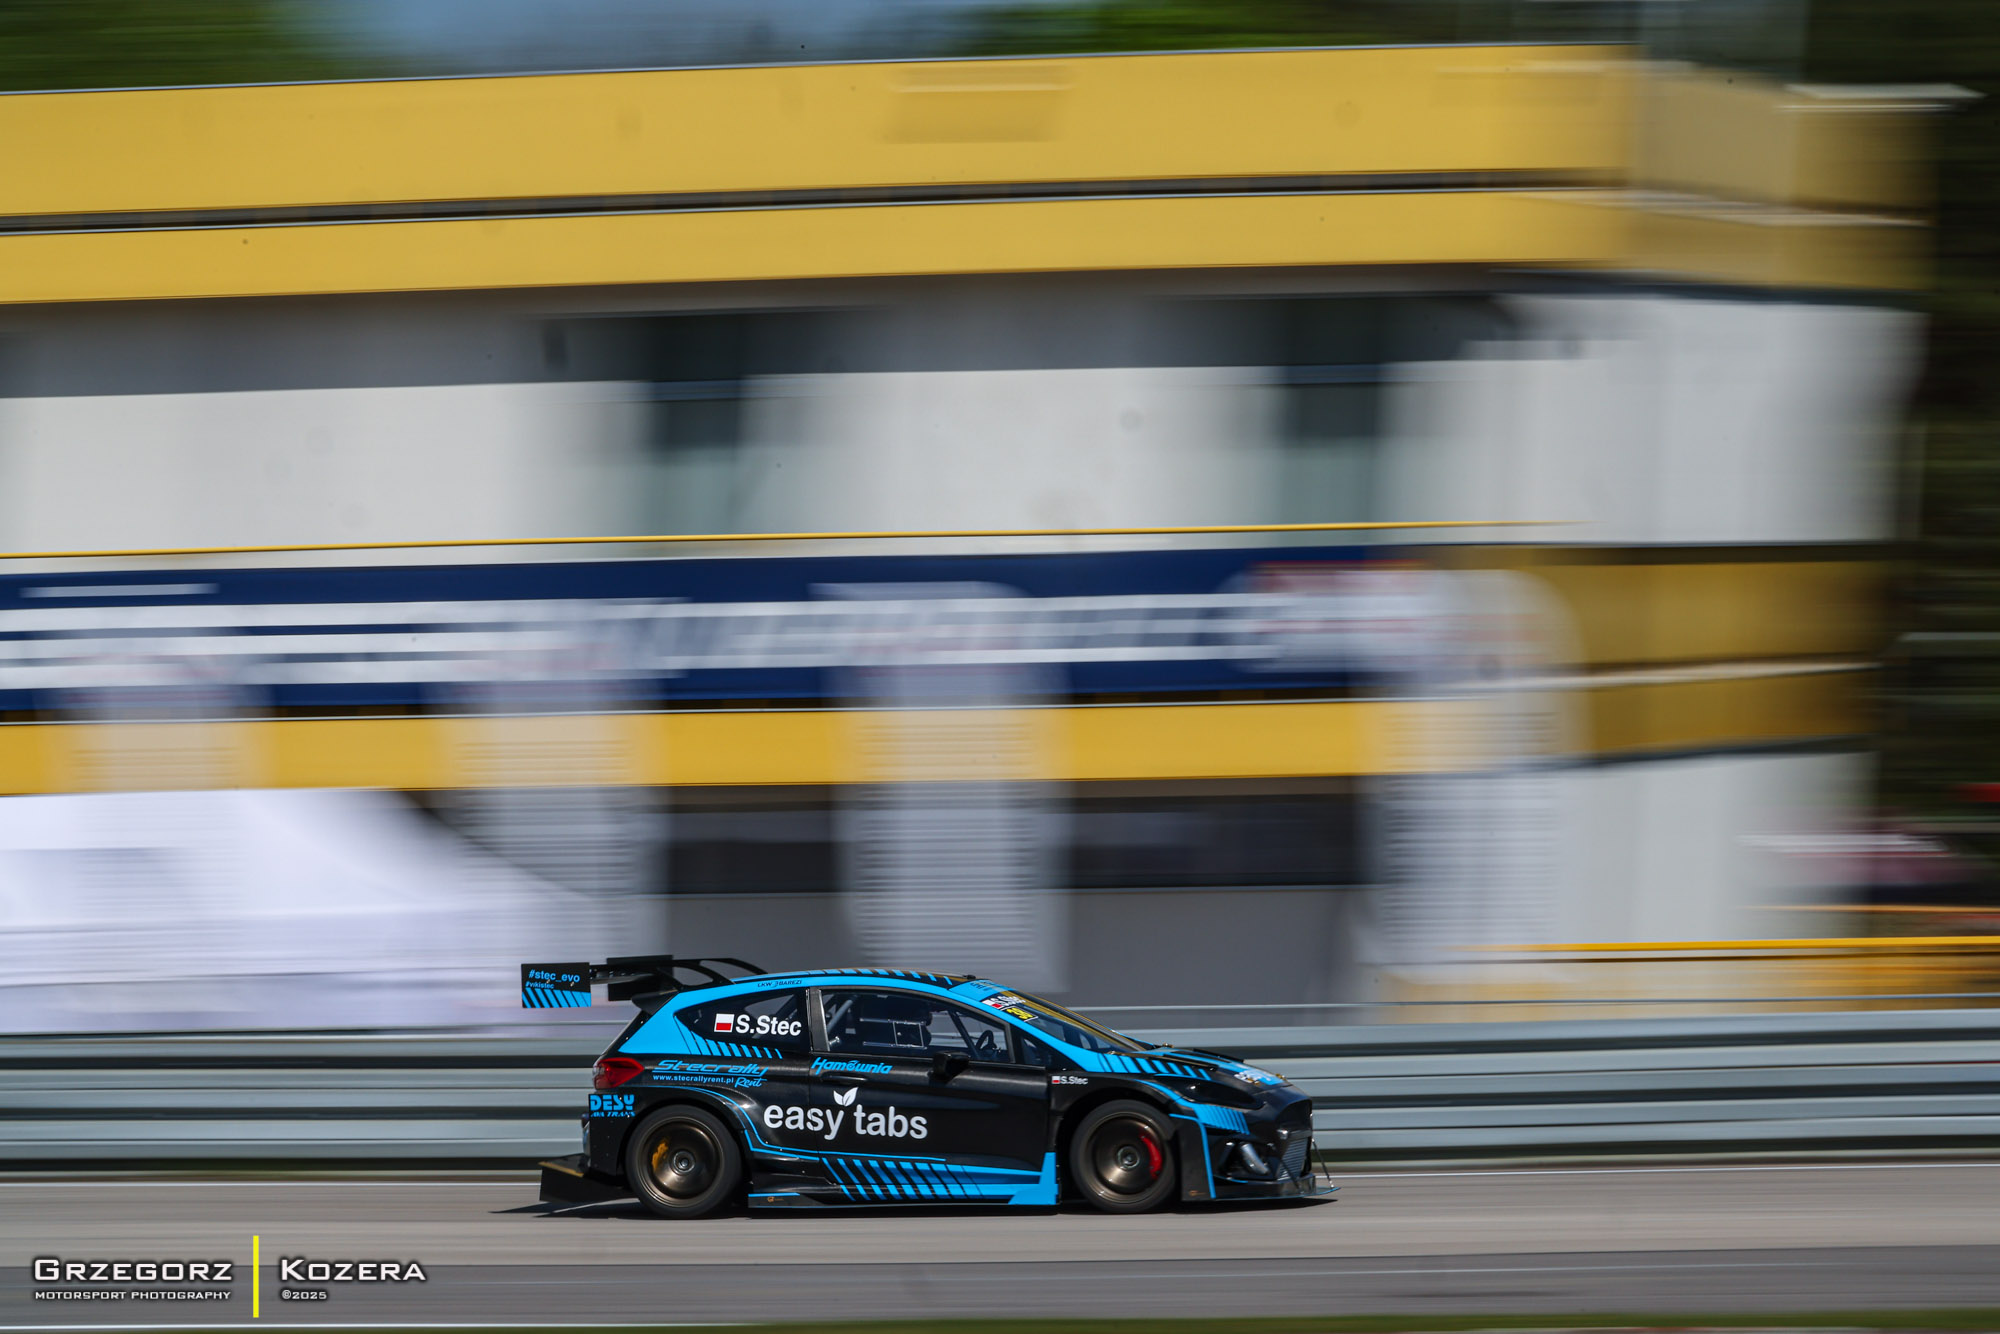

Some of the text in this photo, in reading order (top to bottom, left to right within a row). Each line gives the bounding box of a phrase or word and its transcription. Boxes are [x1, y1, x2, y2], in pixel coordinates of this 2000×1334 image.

[528, 968, 580, 983] #stec_evo
[735, 1014, 802, 1036] S.Stec
[653, 1059, 769, 1076] Stecrally
[653, 1074, 734, 1084] www.stecrallyrent.pl
[734, 1077, 767, 1088] Rent
[1060, 1076, 1088, 1085] S.Stec
[589, 1094, 635, 1111] DESY
[763, 1103, 929, 1141] easy tabs
